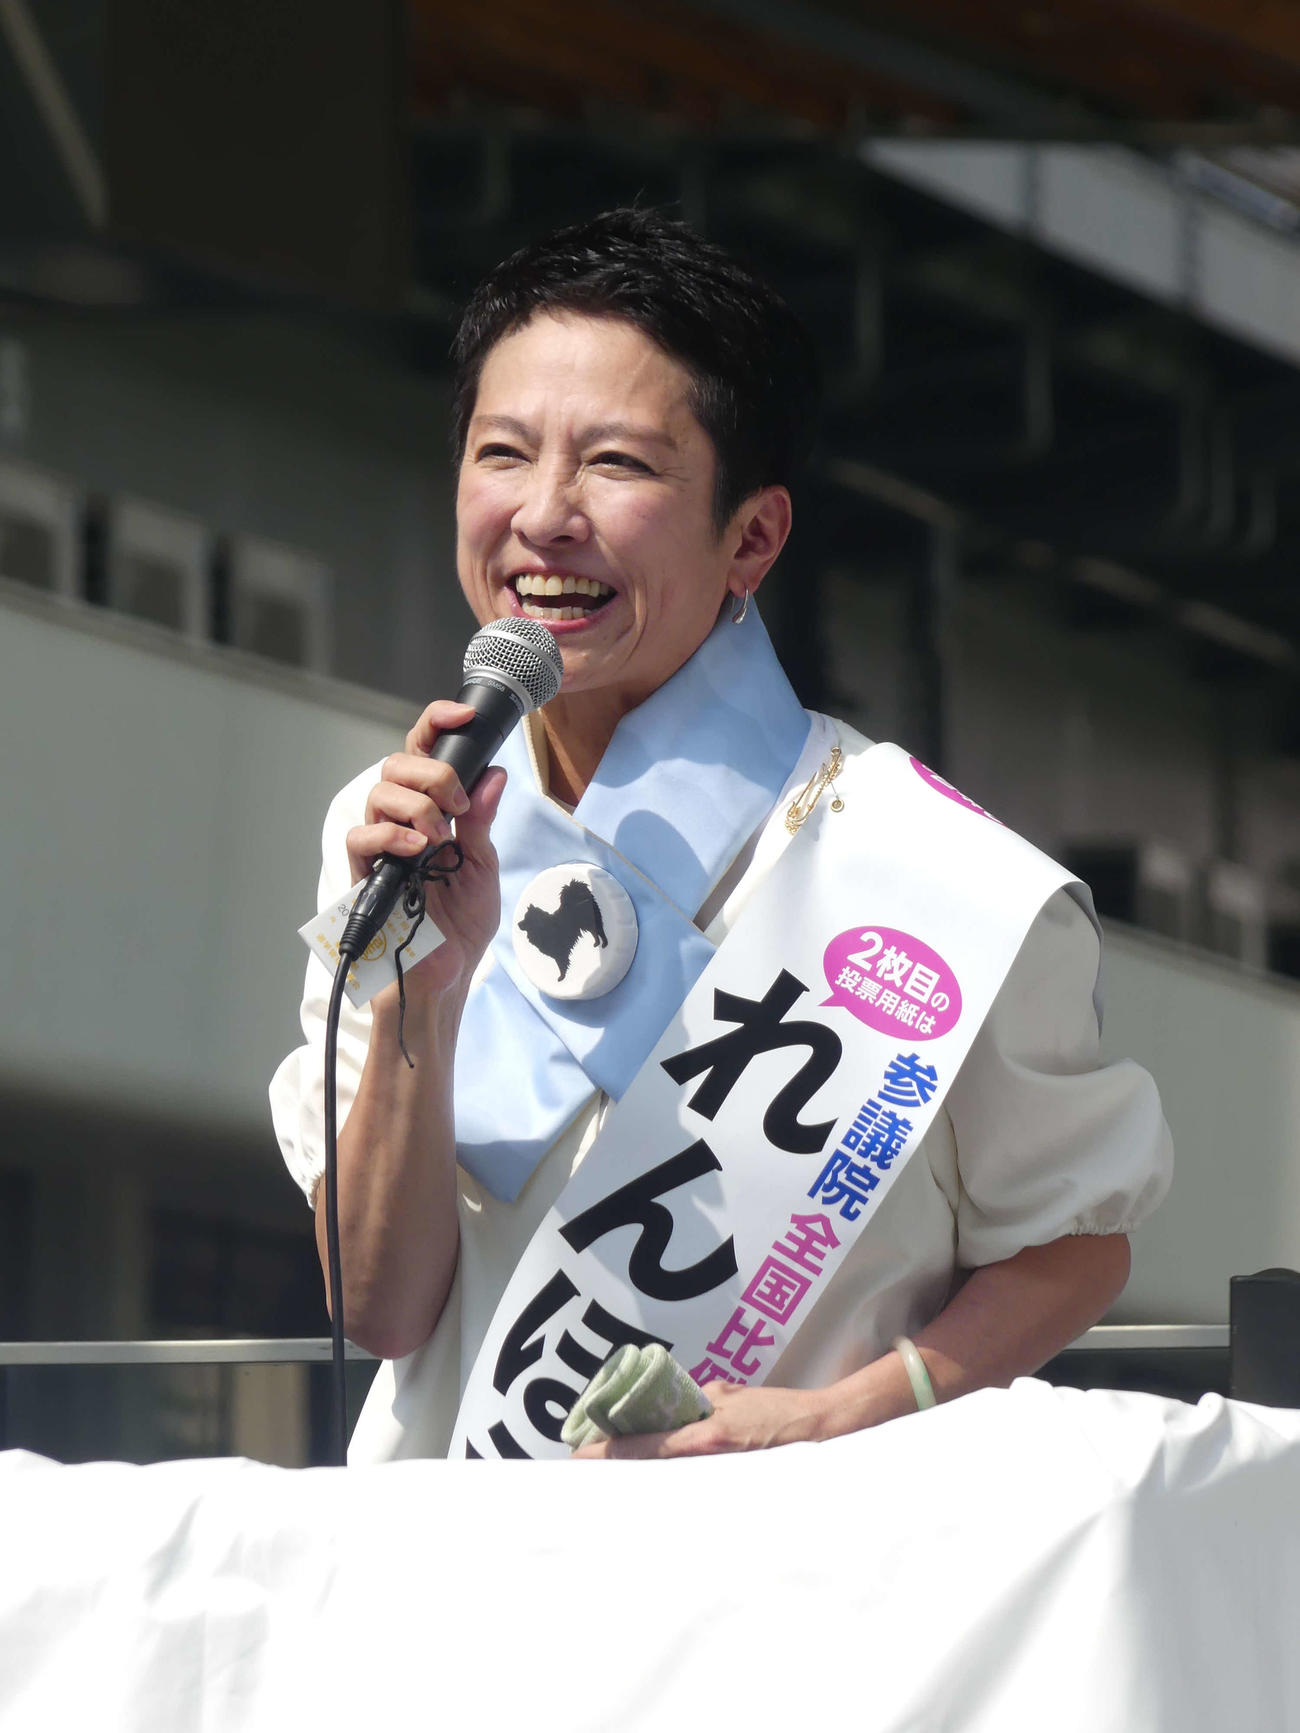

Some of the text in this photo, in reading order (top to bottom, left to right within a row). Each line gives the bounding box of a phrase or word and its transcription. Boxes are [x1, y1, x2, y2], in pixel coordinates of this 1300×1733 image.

[834, 966, 937, 1034] 投票用紙は
[846, 931, 950, 1012] 2枚目の
[465, 967, 844, 1460] れんほ
